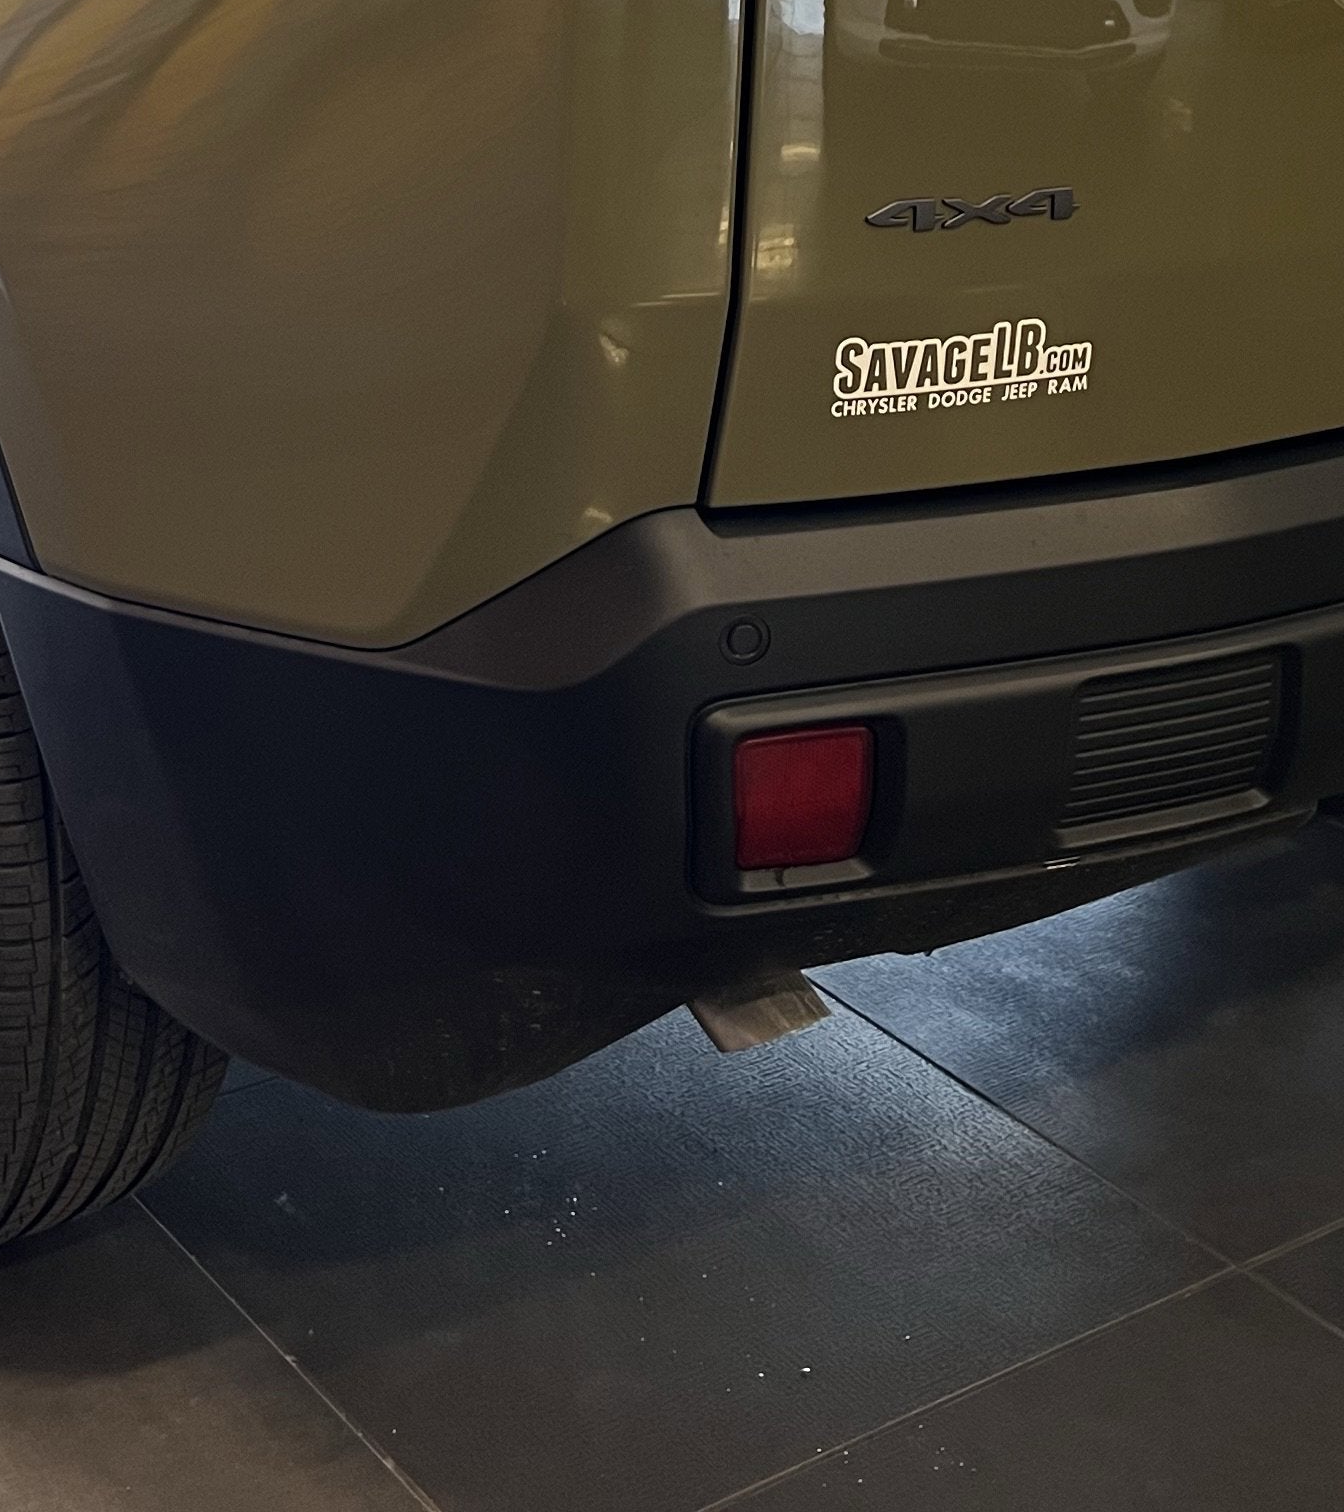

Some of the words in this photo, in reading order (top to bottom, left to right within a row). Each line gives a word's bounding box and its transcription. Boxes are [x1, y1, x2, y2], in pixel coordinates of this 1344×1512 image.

[830, 395, 917, 418] CHRYSLER
[928, 386, 992, 409] DODGE
[1001, 381, 1038, 401] JEEP
[1047, 374, 1088, 396] RAM
